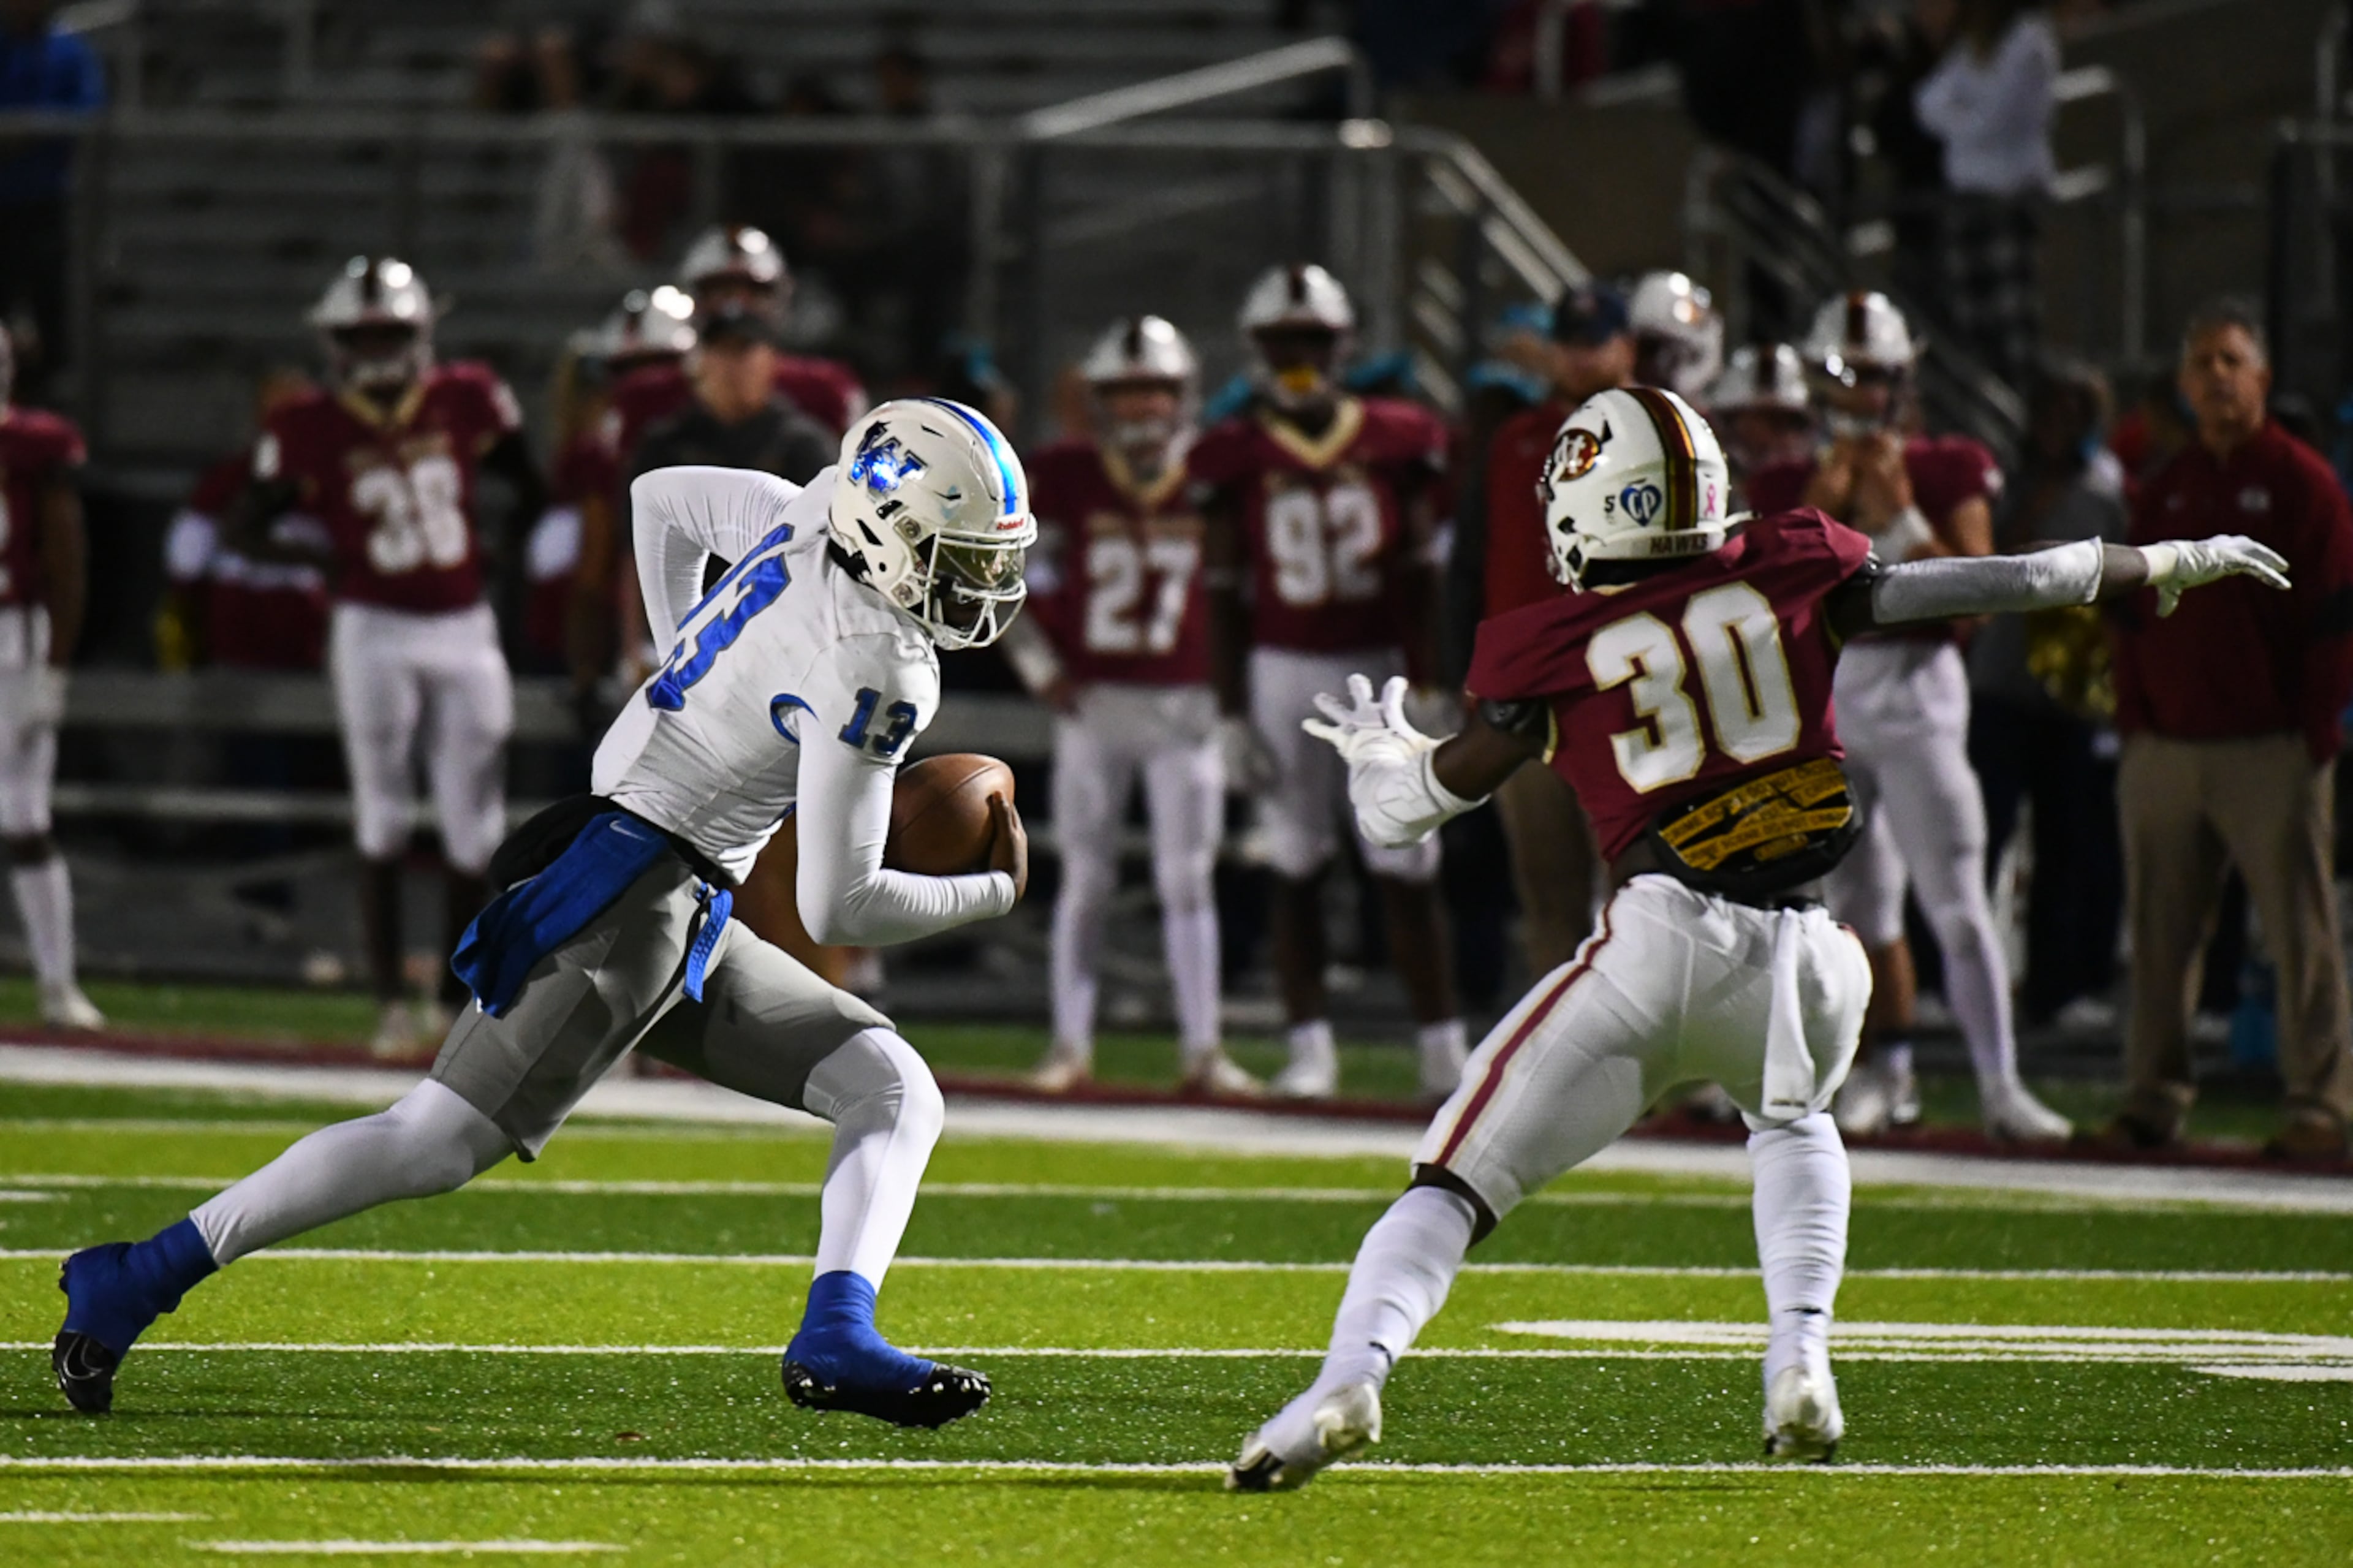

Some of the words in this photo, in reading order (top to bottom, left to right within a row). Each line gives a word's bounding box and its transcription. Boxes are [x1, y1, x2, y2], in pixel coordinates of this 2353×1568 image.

[1086, 538, 1199, 654] 27
[1267, 484, 1381, 604] 92
[646, 522, 795, 711] 13
[838, 686, 918, 756] 13
[1585, 580, 1802, 794] 30
